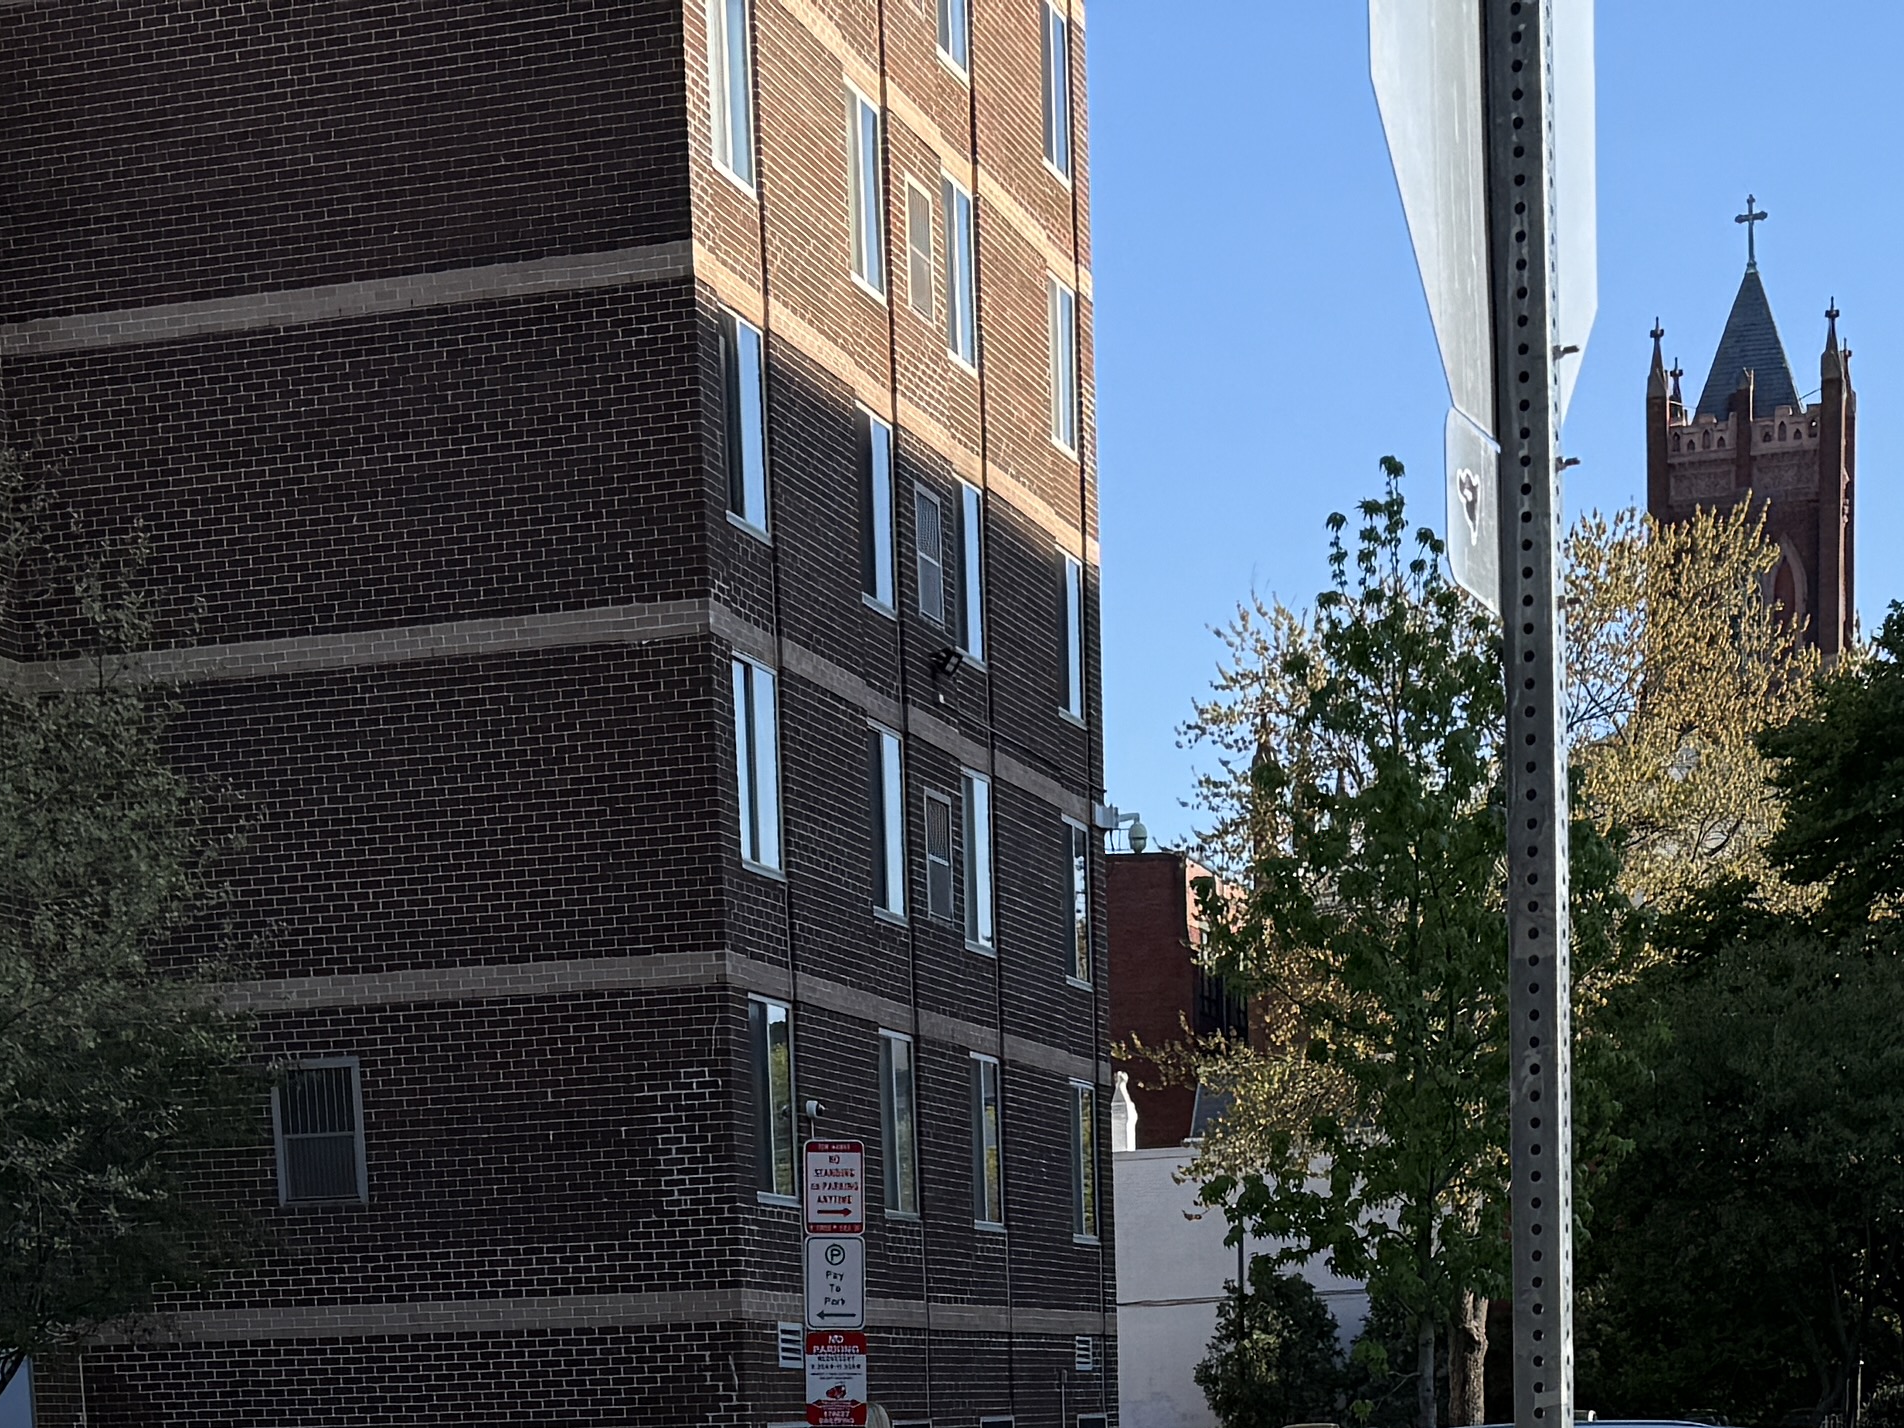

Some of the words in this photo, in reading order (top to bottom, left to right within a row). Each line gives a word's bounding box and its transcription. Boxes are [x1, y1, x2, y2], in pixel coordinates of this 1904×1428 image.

[826, 1270, 844, 1282] Pay
[829, 1284, 841, 1293] To
[824, 1297, 845, 1306] Park
[828, 1335, 844, 1344] NO
[813, 1345, 859, 1353] PARKING
